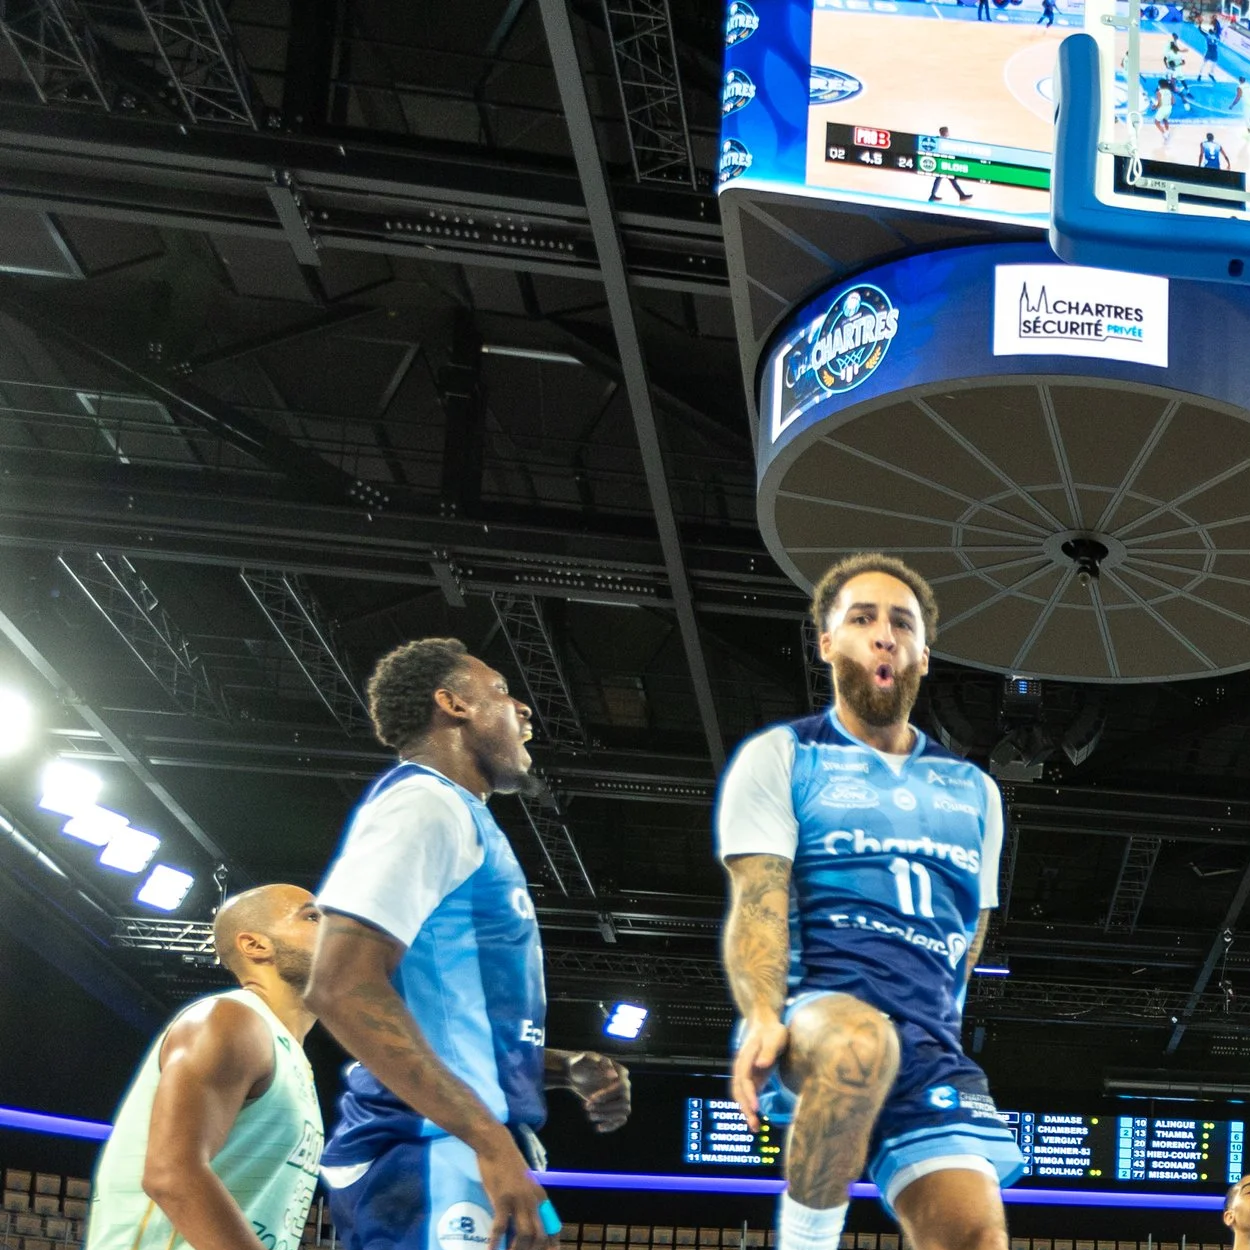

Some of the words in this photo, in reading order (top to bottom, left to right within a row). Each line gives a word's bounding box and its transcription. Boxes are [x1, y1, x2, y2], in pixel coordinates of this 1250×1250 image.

[898, 157, 913, 169] 24
[1053, 300, 1143, 322] CHARTRES
[1022, 316, 1102, 337] SÉCURITÉ
[1107, 324, 1143, 338] PRIVÉE
[812, 309, 899, 371] CHARTRES
[824, 829, 980, 874] Chartres
[889, 856, 934, 919] 11
[709, 1101, 742, 1109] DOUM
[713, 1112, 748, 1120] FORTA
[1044, 1116, 1083, 1124] DAMASE
[1155, 1121, 1196, 1129] ALINGUE
[1038, 1126, 1089, 1135] CHAMBERS
[1156, 1131, 1194, 1139] THAMBA
[1042, 1136, 1083, 1144] VERGIAT
[713, 1144, 751, 1153] NWAMU
[1152, 1141, 1197, 1150] MORENCY
[701, 1154, 761, 1163] WASHINGTO
[1147, 1150, 1202, 1160] HIEU-COURT
[1034, 1156, 1064, 1165] YIMGA
[1152, 1161, 1196, 1169] SCONARD
[1039, 1167, 1083, 1176] SOULHAC
[1149, 1171, 1198, 1180] MISSIA-DIO
